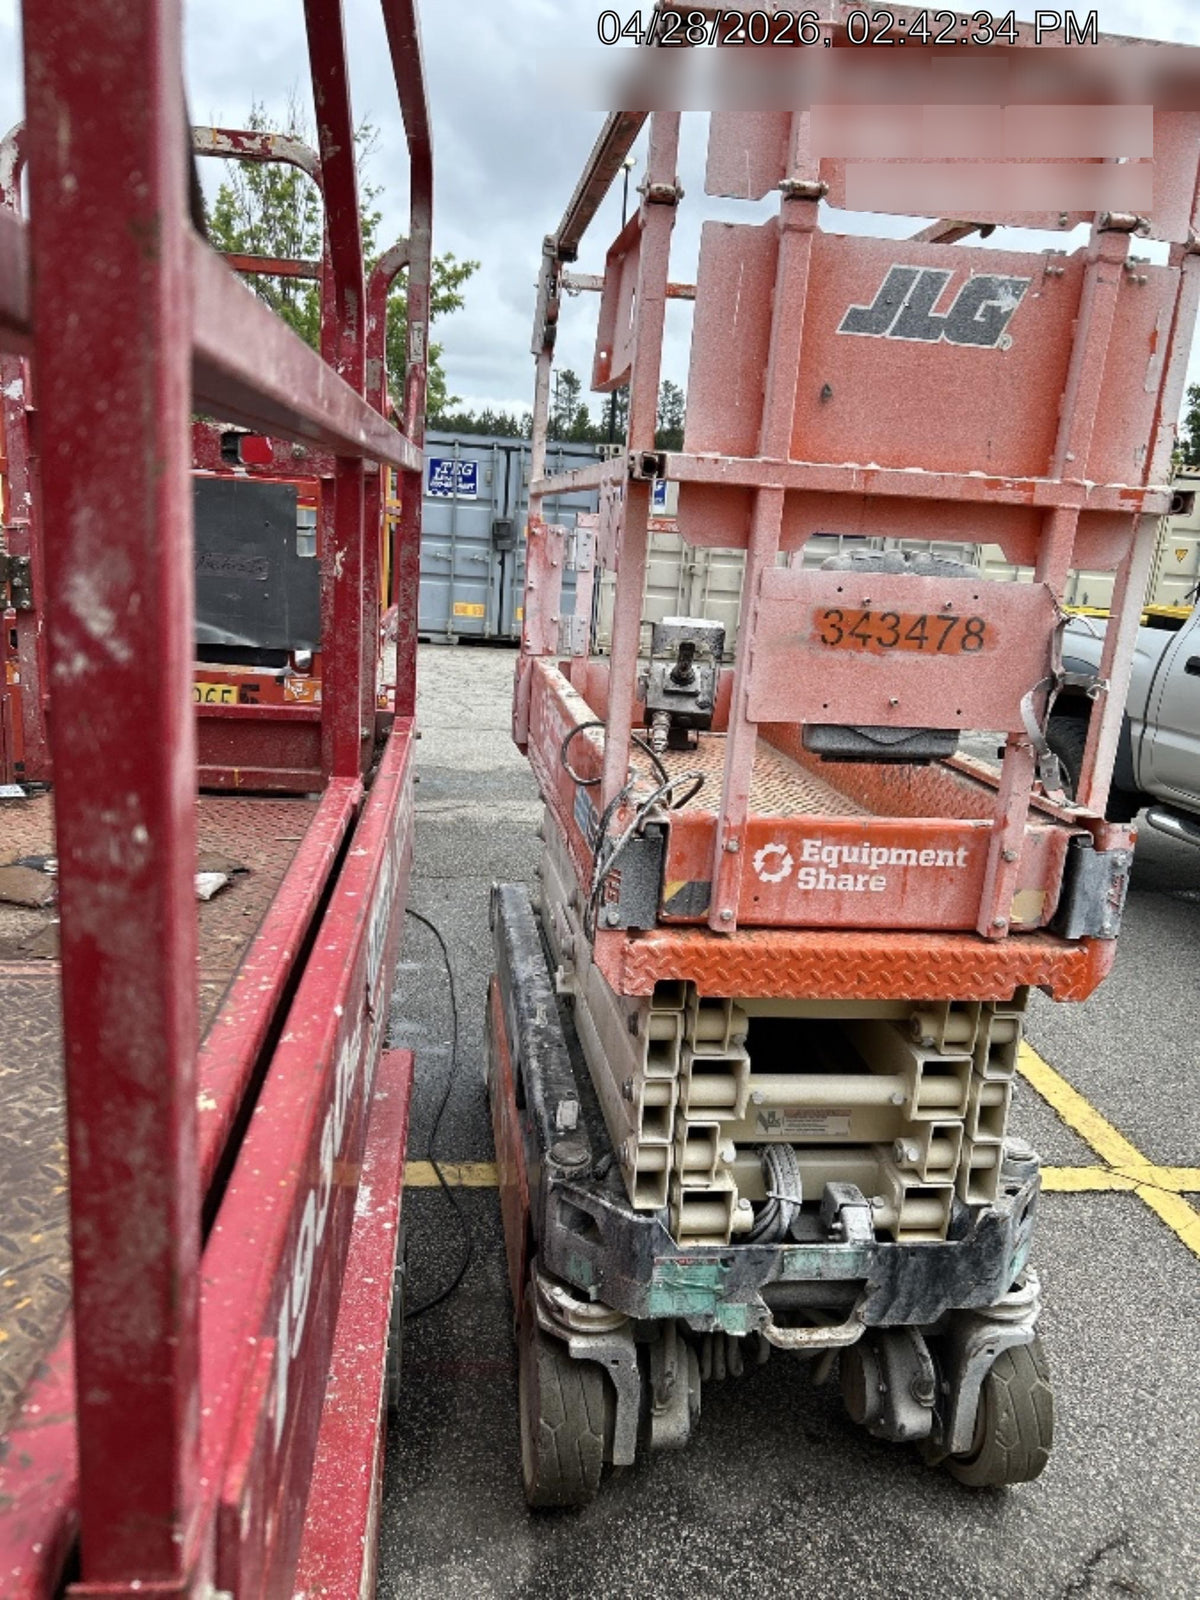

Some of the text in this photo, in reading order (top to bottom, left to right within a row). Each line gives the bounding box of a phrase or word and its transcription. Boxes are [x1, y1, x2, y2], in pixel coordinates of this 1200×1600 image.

[836, 263, 1032, 349] JLG
[820, 609, 985, 652] 343478
[801, 839, 968, 870] Equipment
[798, 867, 887, 892] Share
